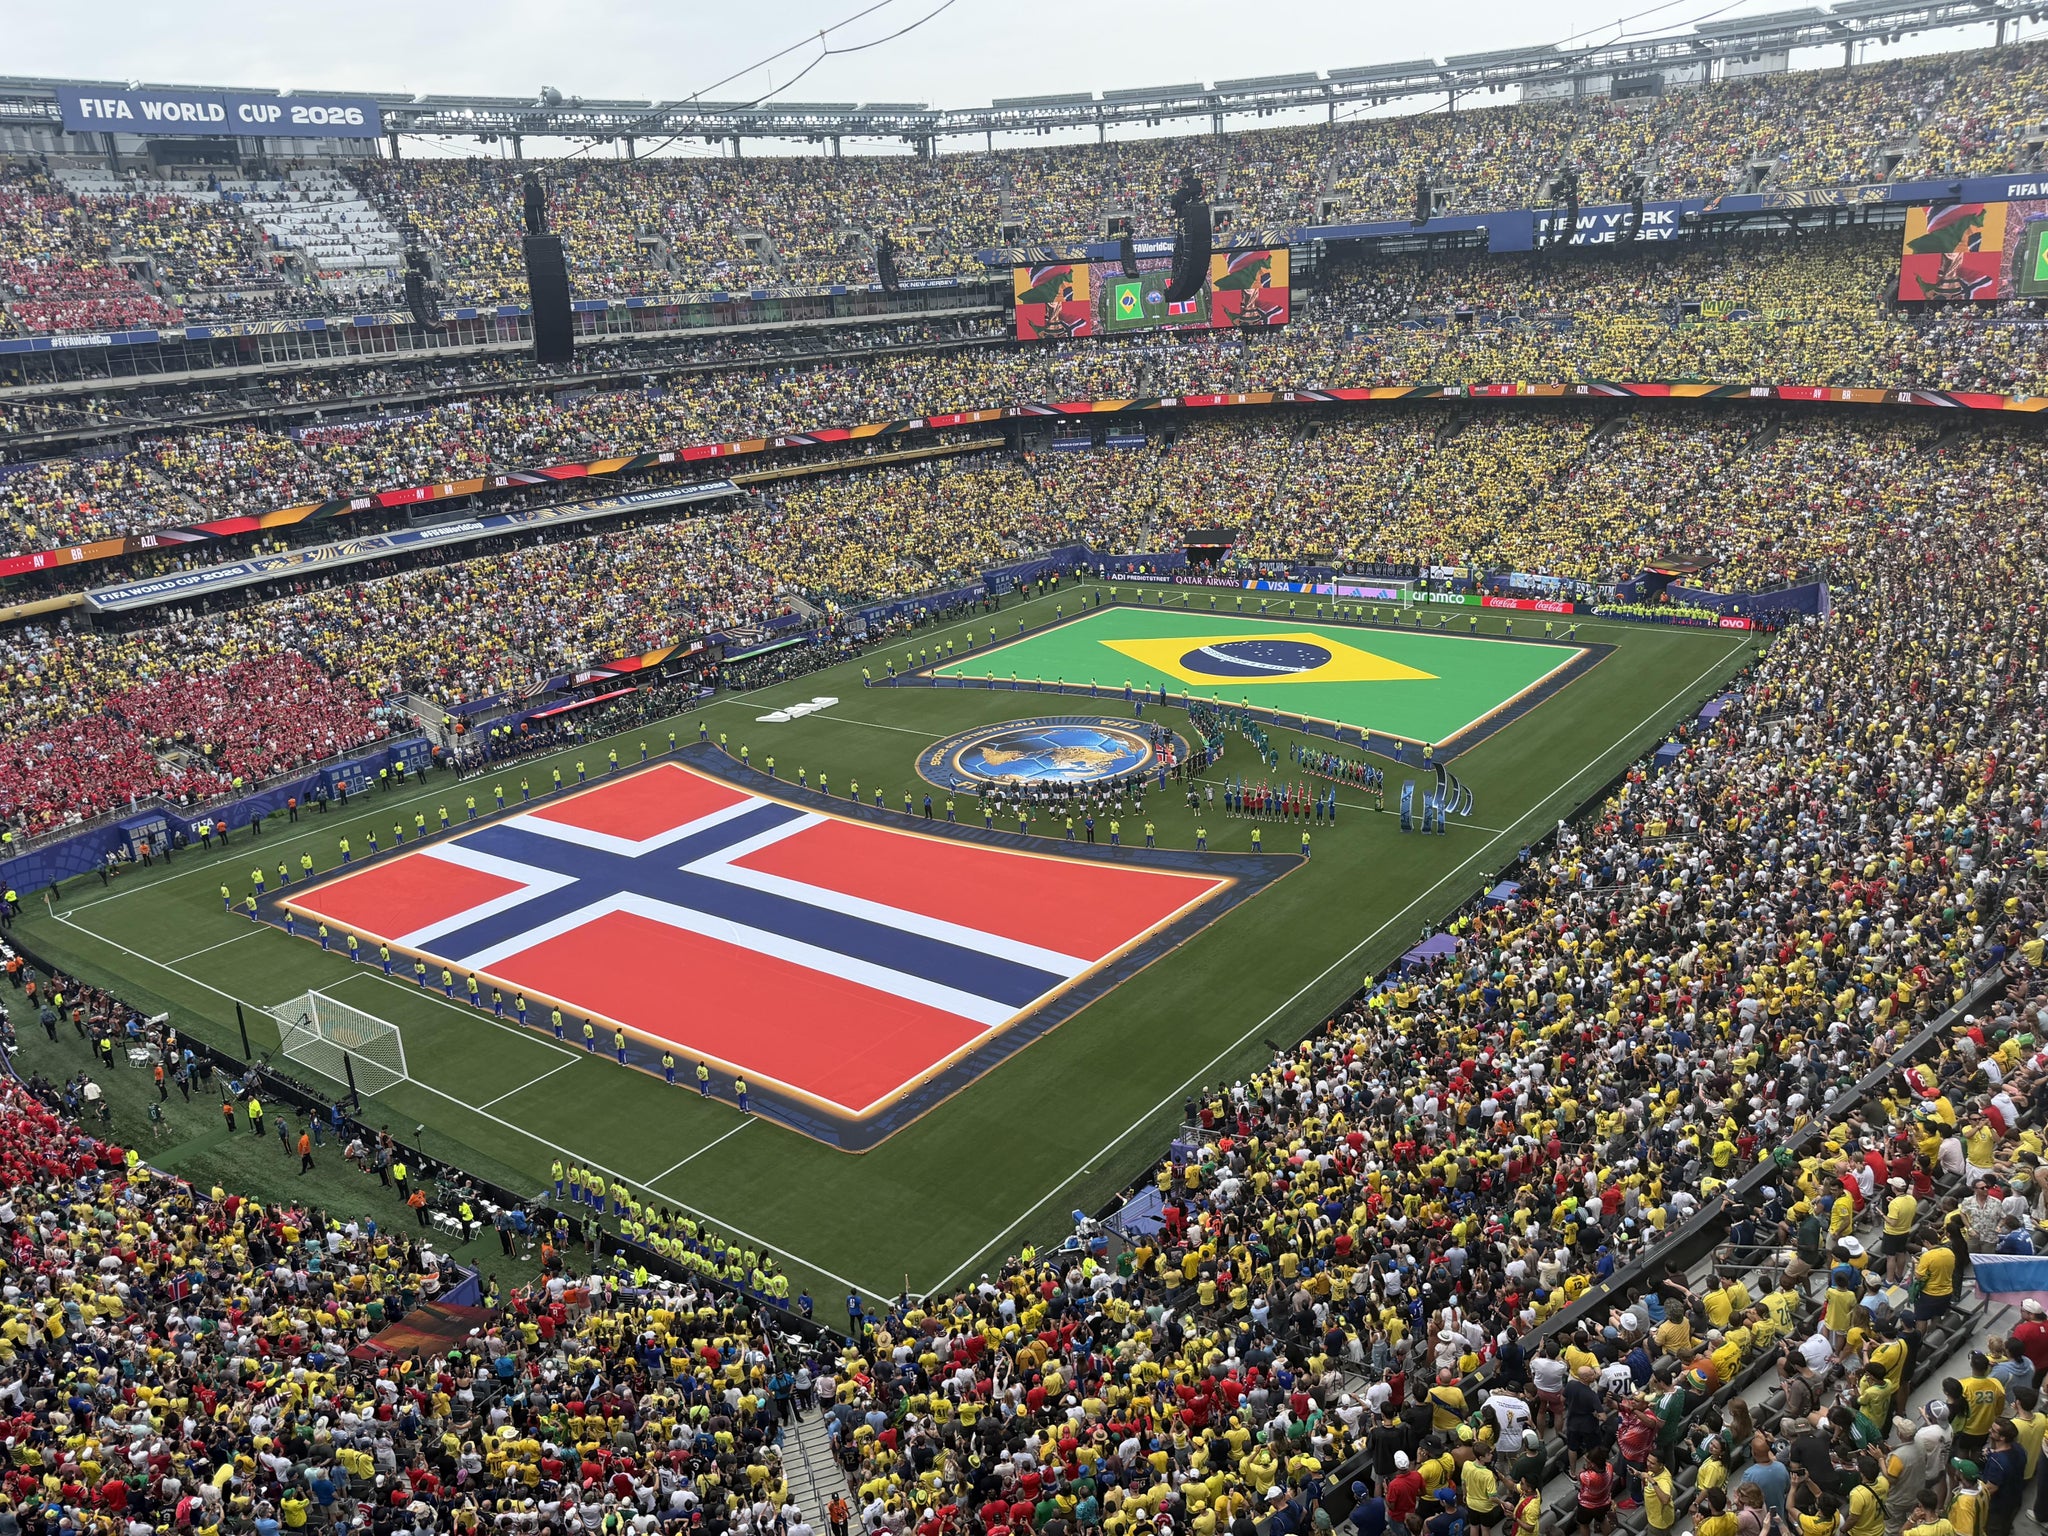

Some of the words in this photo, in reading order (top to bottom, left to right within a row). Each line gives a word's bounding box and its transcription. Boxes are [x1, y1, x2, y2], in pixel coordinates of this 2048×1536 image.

[79, 98, 133, 119] FIFA
[140, 101, 225, 122] WORLD
[238, 104, 282, 123] CUP
[291, 106, 364, 125] 2026
[2008, 184, 2038, 196] FIFA
[51, 335, 112, 348] #FIFAWorldCup
[496, 477, 509, 486] AZIL
[649, 490, 681, 499] WORLD
[70, 548, 83, 560] BR
[140, 535, 158, 548] AZIL
[100, 591, 130, 601] FIFA
[128, 581, 176, 596] WORLD
[177, 576, 200, 586] CUP
[201, 567, 244, 580] 2026
[1176, 576, 1202, 585] QATAR
[1206, 578, 1240, 587] AIRWAYS
[1268, 581, 1290, 592] VISA
[1412, 591, 1465, 604] aramco
[191, 818, 214, 832] FIFA
[1917, 1073, 1925, 1087] 8
[1573, 1281, 1582, 1289] 12
[1612, 1378, 1632, 1395] 20
[1975, 1391, 1994, 1404] 23
[692, 1462, 699, 1470] 9
[662, 1477, 668, 1486] 6
